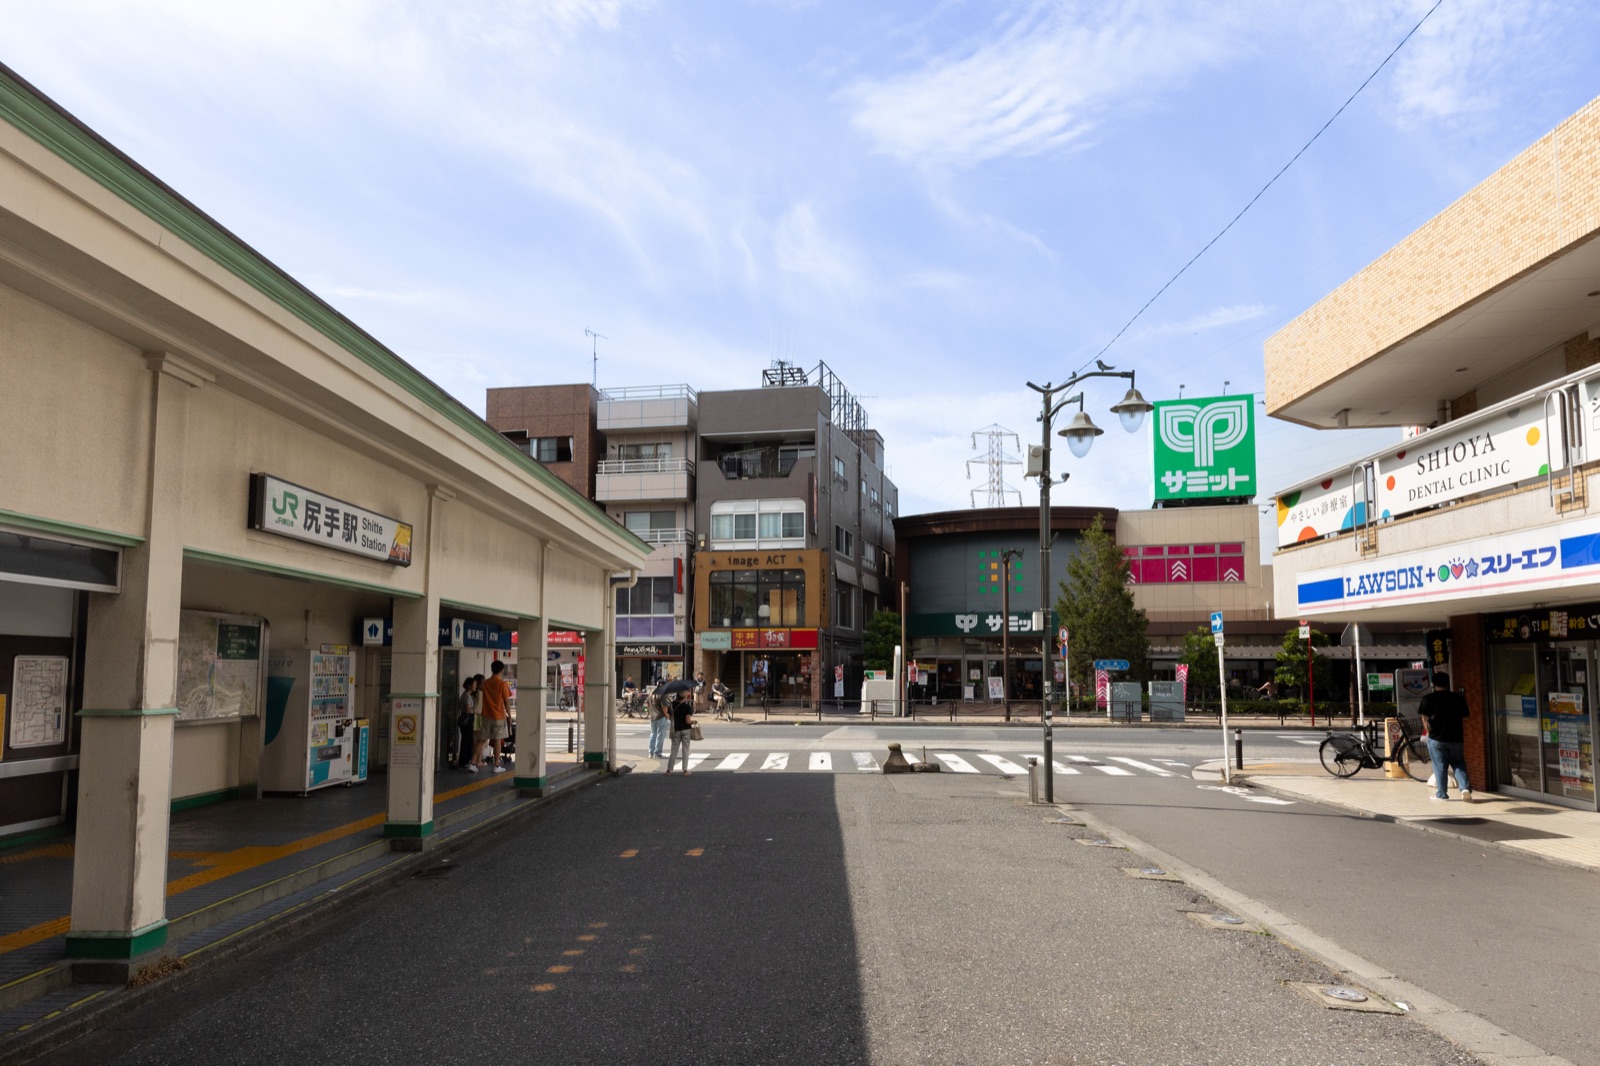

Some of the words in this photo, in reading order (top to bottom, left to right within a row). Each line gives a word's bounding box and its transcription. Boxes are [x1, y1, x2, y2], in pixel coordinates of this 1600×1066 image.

[1416, 432, 1496, 476] SHIOYA
[1160, 467, 1250, 494] サミット
[1408, 477, 1454, 502] DENTAL
[1459, 460, 1510, 486] CLINIC
[272, 490, 298, 520] JR
[1291, 494, 1348, 523] やさしい診療室
[302, 499, 358, 544] 尻手駅
[362, 517, 383, 536] Shitte
[361, 535, 387, 553] Station
[728, 556, 759, 567] image
[766, 554, 786, 564] ACT
[1346, 565, 1423, 597] LAWSON
[1481, 545, 1556, 576] スリーエフ
[489, 632, 498, 641] ATM
[986, 614, 1032, 632] サミッ
[1562, 750, 1578, 758] ATM
